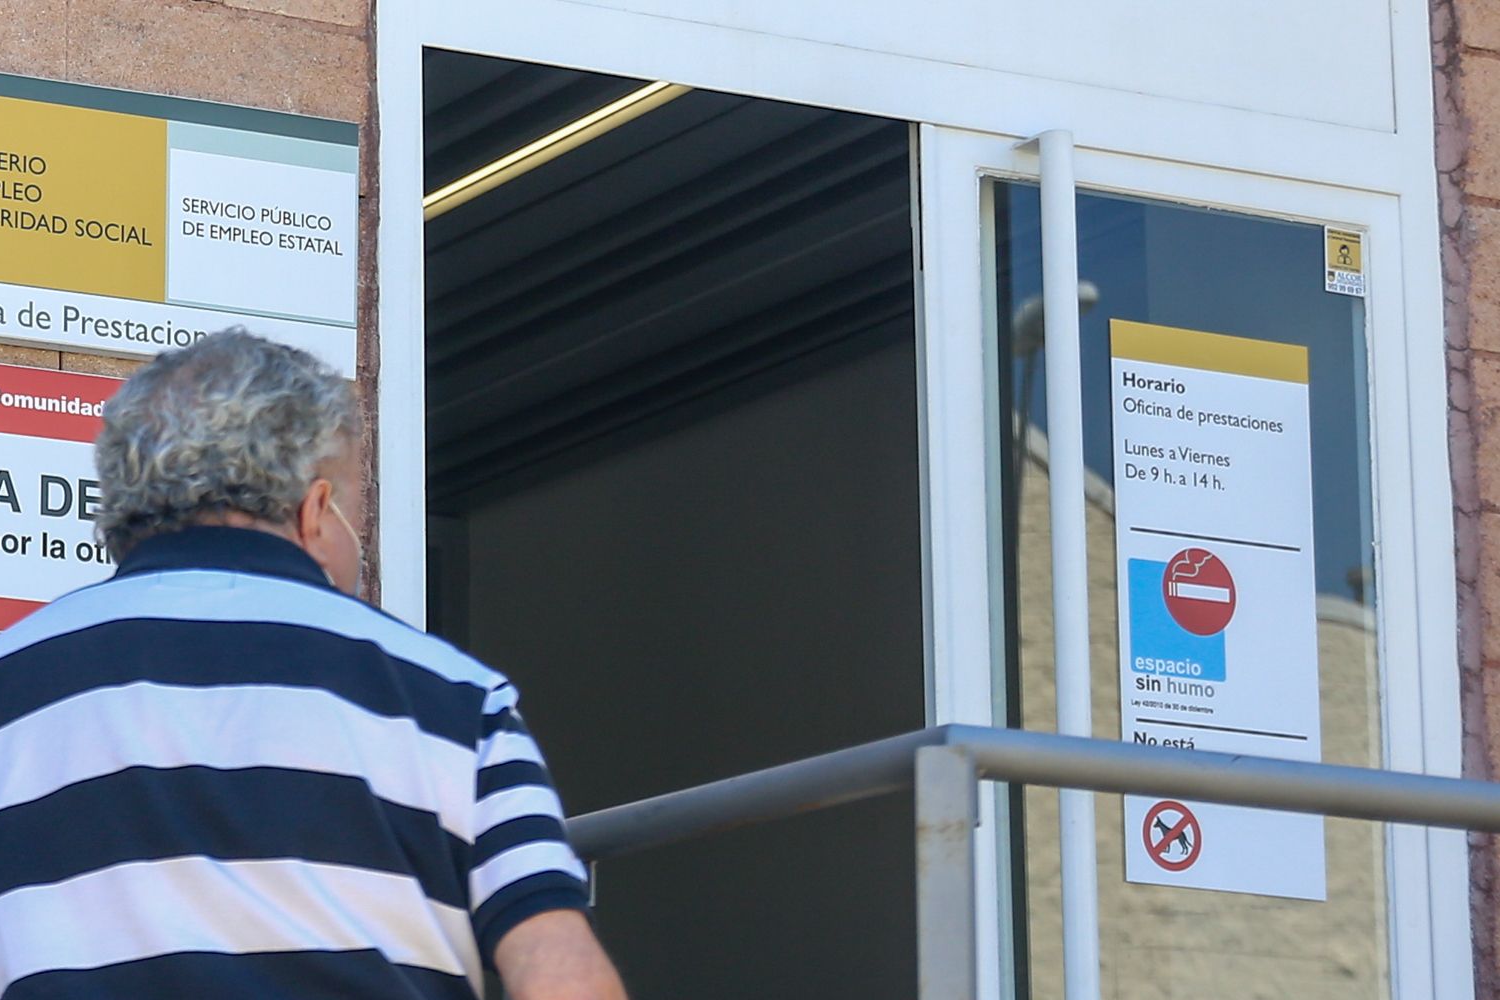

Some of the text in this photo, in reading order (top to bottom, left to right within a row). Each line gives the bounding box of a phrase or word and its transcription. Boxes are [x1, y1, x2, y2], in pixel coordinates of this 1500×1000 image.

[182, 197, 332, 231] SERVICIO PÚBLICO
[75, 219, 152, 246] SOCIAL
[182, 220, 343, 256] DE EMPLEO ESTATAL
[18, 302, 52, 331] de
[1122, 372, 1185, 394] Horario
[1123, 397, 1283, 433] Oficina de prestaciones
[1124, 439, 1230, 467] Lunes a Viernes
[1125, 463, 1146, 480] De
[1151, 467, 1159, 482] 9
[1179, 474, 1186, 486] a
[1193, 472, 1207, 488] 14
[1212, 475, 1225, 491] h.
[41, 474, 102, 521] DE
[42, 532, 66, 559] la
[1135, 657, 1201, 675] espacio
[1136, 675, 1214, 697] sin humo
[1134, 731, 1195, 750] No está
